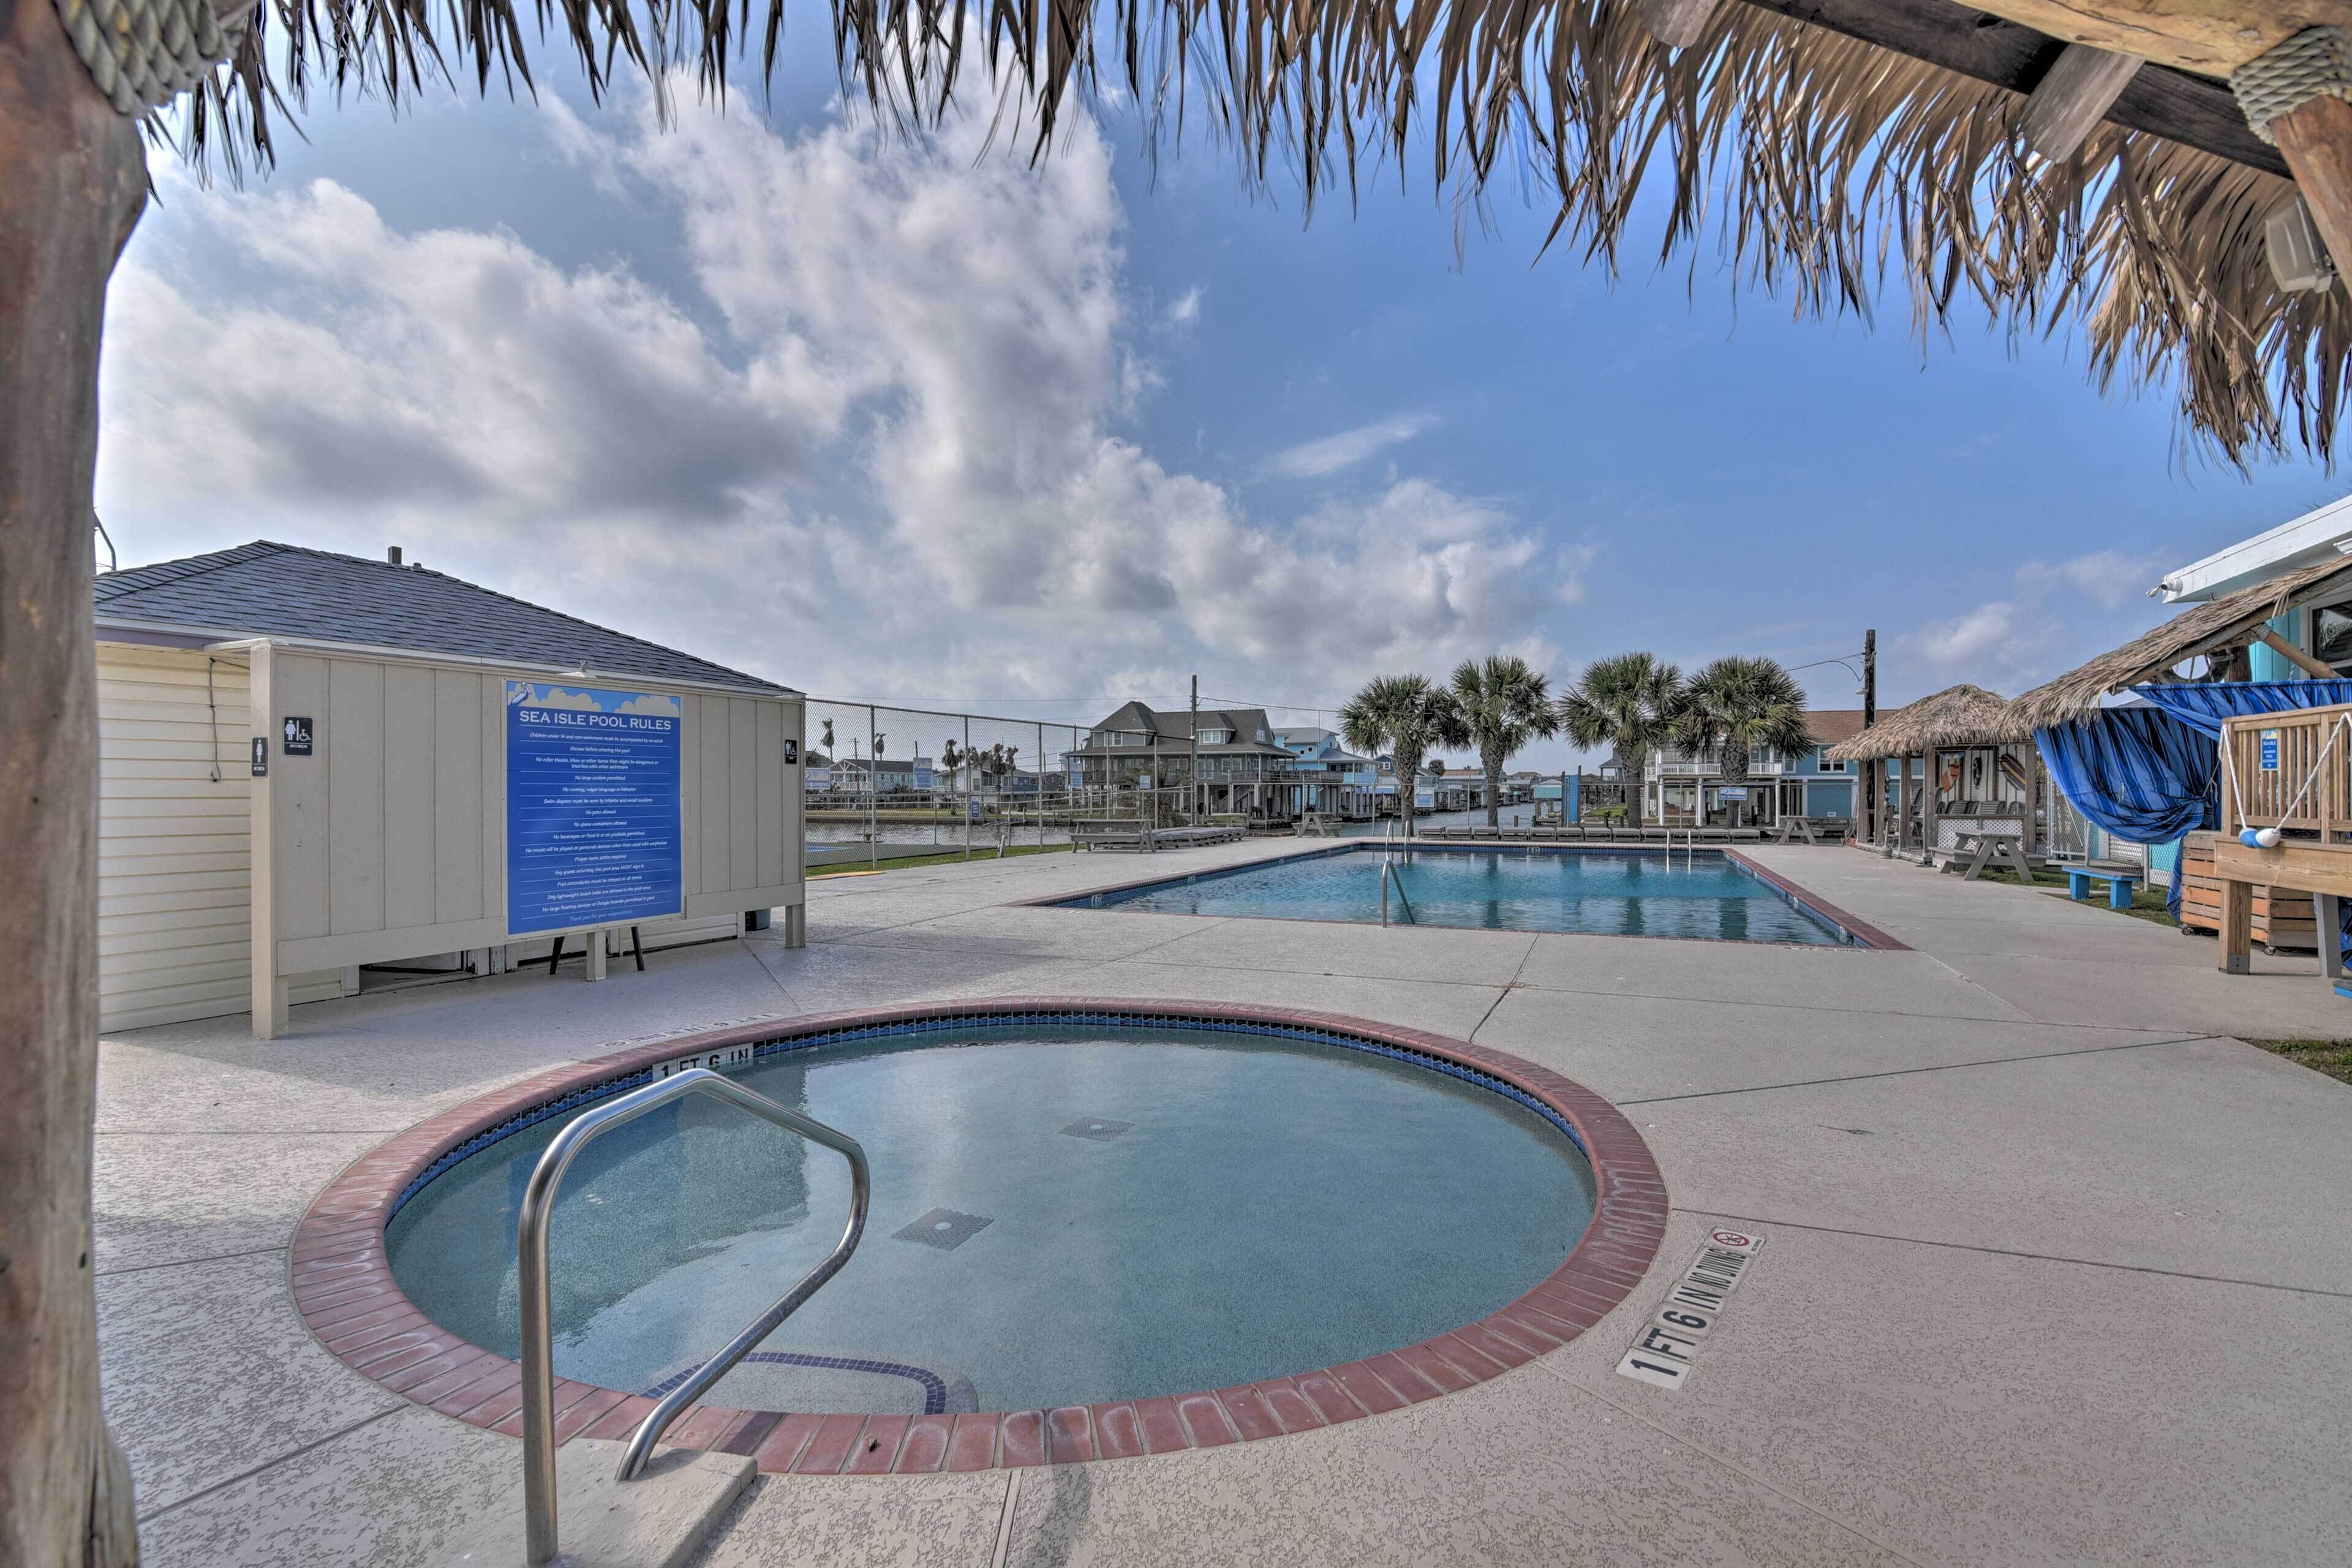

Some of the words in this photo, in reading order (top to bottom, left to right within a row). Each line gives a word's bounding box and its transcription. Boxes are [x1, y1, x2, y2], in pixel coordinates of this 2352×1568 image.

[520, 710, 551, 723] SEA
[555, 713, 586, 725] ISLE
[589, 715, 627, 728] POOL
[630, 718, 671, 730] RULES
[662, 1065, 669, 1077] 1
[679, 1057, 700, 1071] FT
[731, 1048, 748, 1064] IN
[1695, 1248, 1747, 1278] DIVING
[1687, 1272, 1732, 1291] NO
[1673, 1286, 1722, 1311] IN
[1662, 1311, 1707, 1329] 6
[1642, 1328, 1696, 1360] FT
[1630, 1359, 1679, 1377] 1
